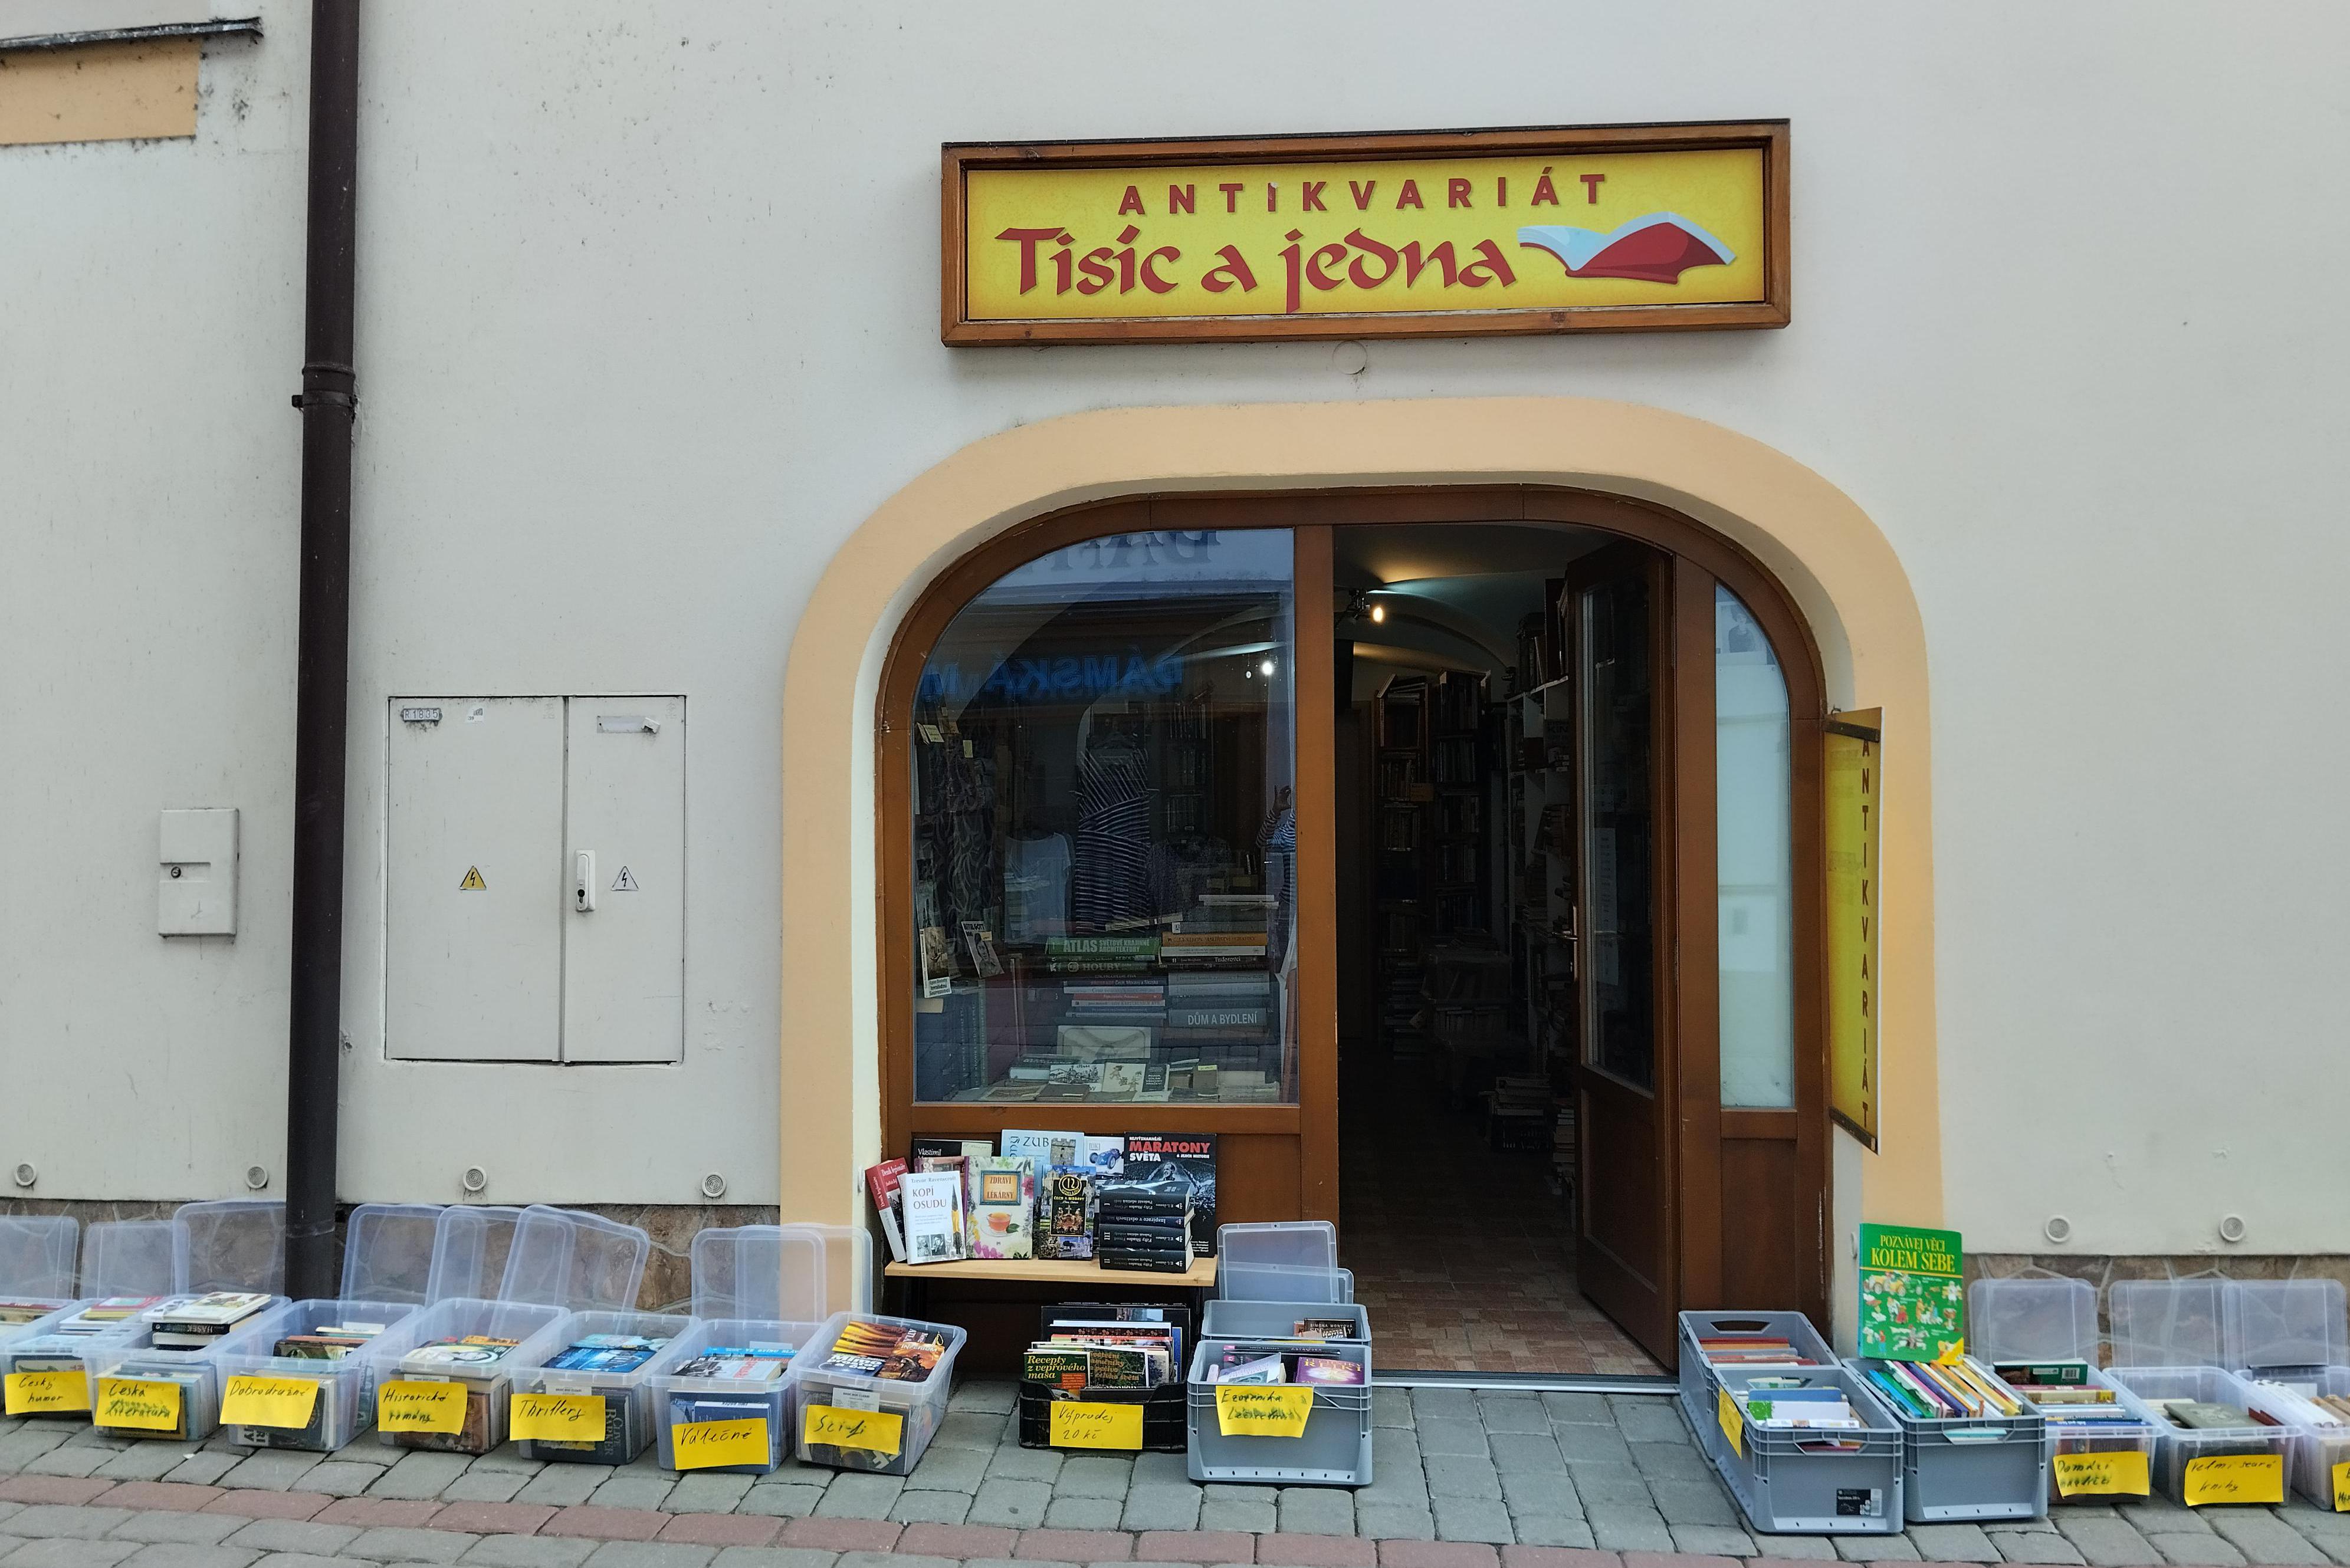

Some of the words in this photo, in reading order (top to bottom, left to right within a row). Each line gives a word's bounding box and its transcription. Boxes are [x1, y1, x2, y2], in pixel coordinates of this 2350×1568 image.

[1117, 166, 1606, 216] ANTIKVARIÁT
[995, 225, 1180, 296] Tisíc
[1202, 244, 1258, 293] a
[1278, 226, 1518, 314] jedna
[1861, 739, 1870, 1127] ANTIKVARIÁT
[1063, 940, 1098, 952] ATLAS
[1188, 1011, 1209, 1025] DŮM
[1212, 1014, 1217, 1024] A
[1220, 1011, 1258, 1024] BYDLENÍ
[1023, 1136, 1049, 1146] ZUB
[1129, 1141, 1210, 1153] MARATONY
[918, 1148, 941, 1156] Vlastimil
[1129, 1151, 1161, 1162] SVĚTA
[990, 1175, 1012, 1185] ZDRAVÍ
[1067, 1178, 1075, 1189] 12
[913, 1185, 934, 1197] KOPÍ
[987, 1189, 1014, 1199] LÉKÁRNY
[913, 1199, 947, 1209] OSUDU
[1880, 1234, 1923, 1251] POZNÁVEJ
[1925, 1237, 1945, 1251] VĚCI
[1871, 1247, 1917, 1270] KOLEM
[1921, 1253, 1955, 1273] SEBE
[1028, 1355, 1066, 1367] Recepty
[1035, 1363, 1086, 1374] vepřového
[19, 1375, 57, 1389] Český
[109, 1380, 149, 1397] Česká
[229, 1380, 310, 1397] Dobrodružné
[28, 1392, 64, 1403] humor
[384, 1388, 448, 1403] Historické
[518, 1399, 585, 1422] Thrillery
[1059, 1404, 1114, 1426] Výprodej
[813, 1415, 867, 1439] Sci-fi
[681, 1427, 752, 1446] Válečné
[1063, 1429, 1080, 1440] 20
